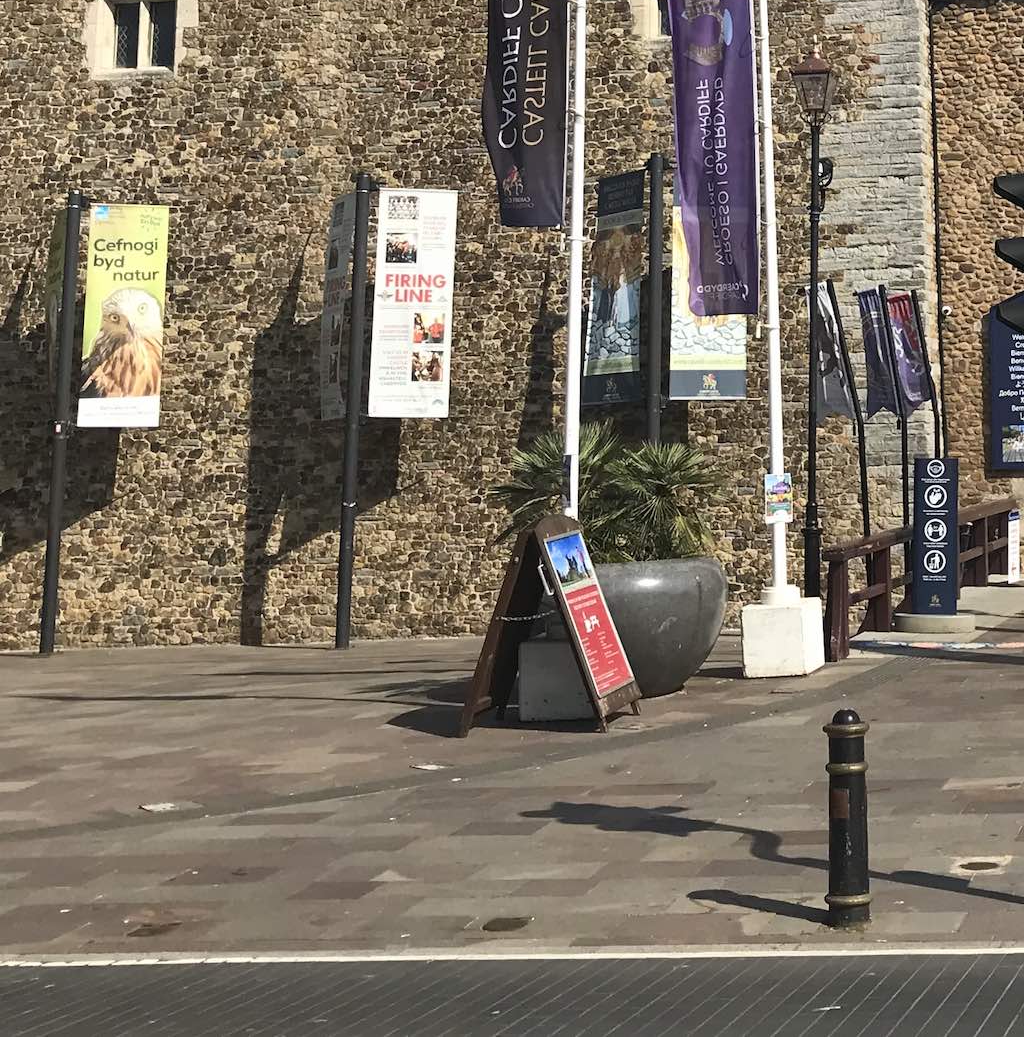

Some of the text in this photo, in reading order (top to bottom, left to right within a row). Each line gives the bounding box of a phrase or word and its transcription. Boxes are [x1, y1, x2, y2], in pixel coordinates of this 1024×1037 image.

[94, 238, 158, 255] Cefnogi
[93, 254, 125, 271] byd
[113, 268, 159, 281] natur
[385, 273, 446, 288] FIRING
[394, 289, 432, 303] LINE
